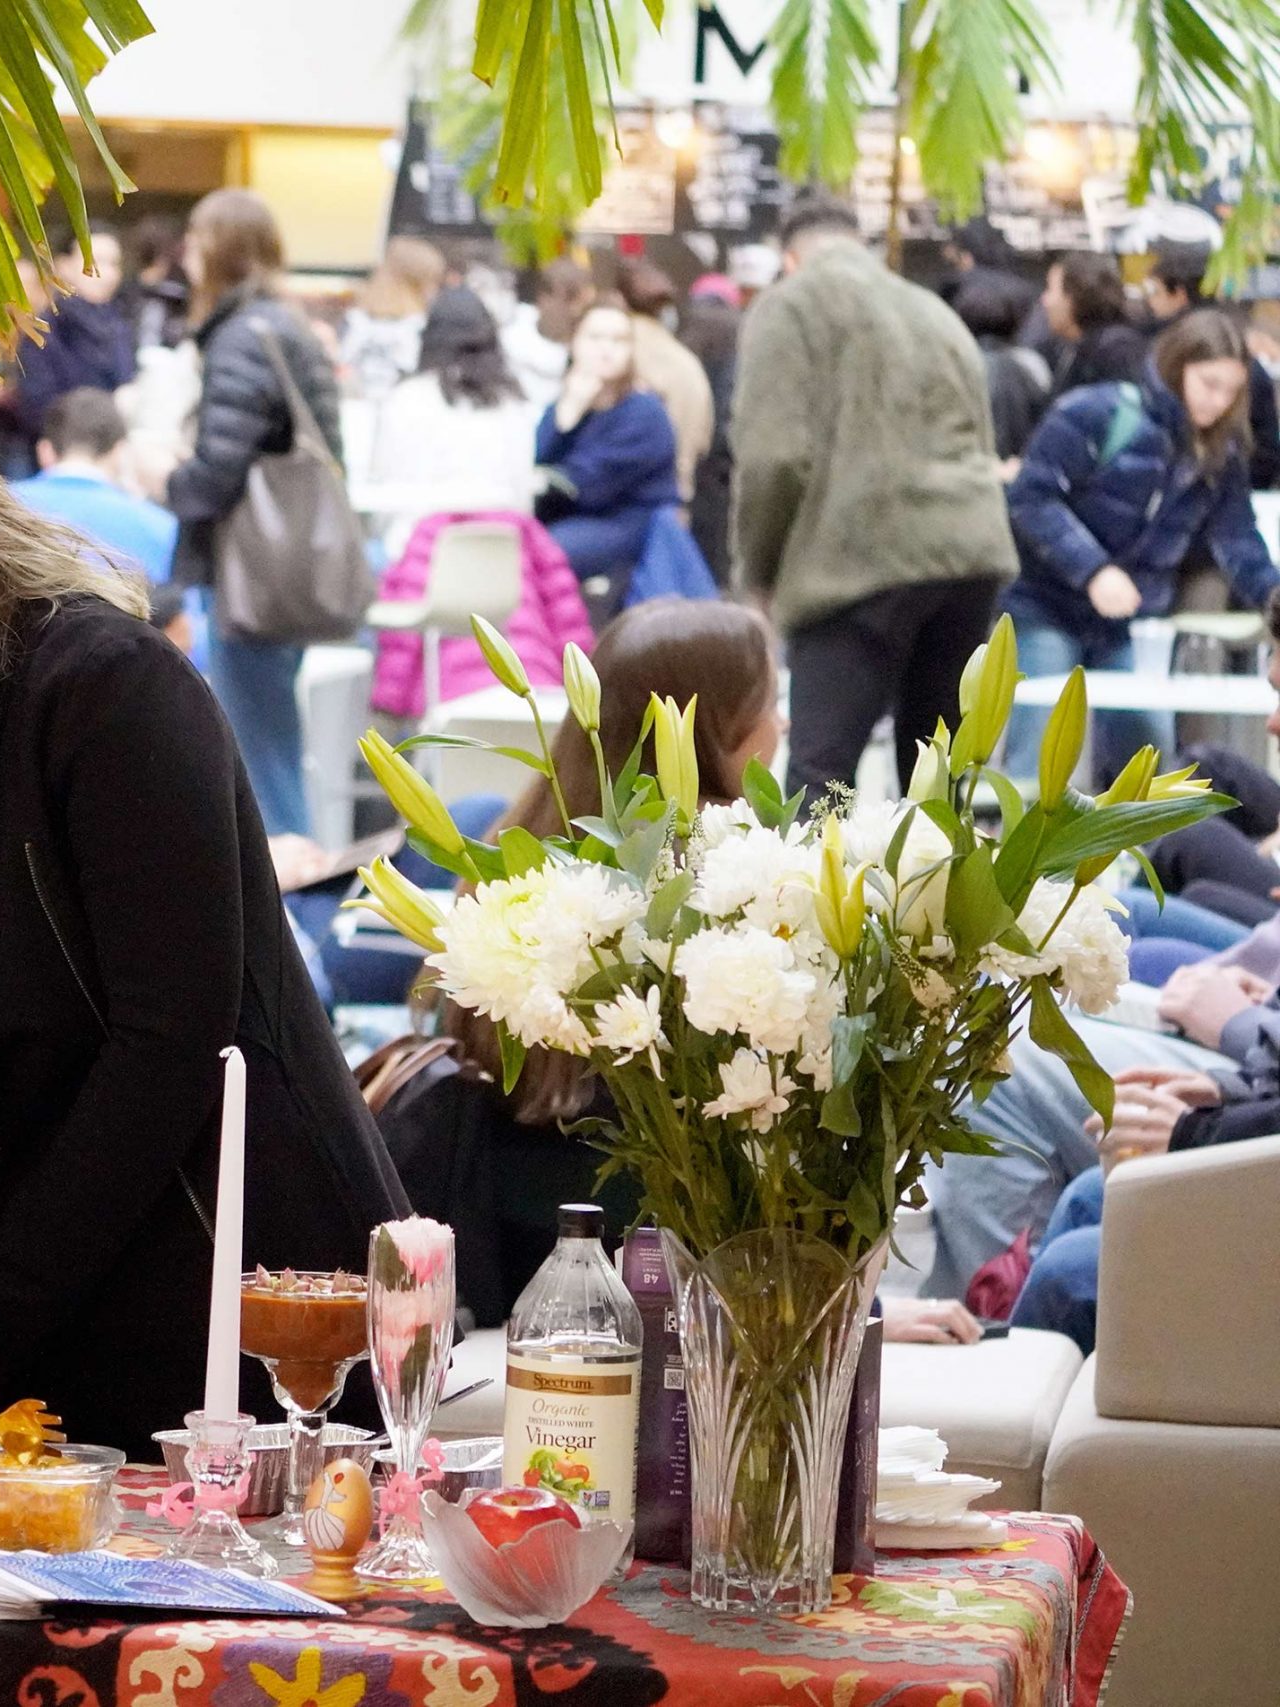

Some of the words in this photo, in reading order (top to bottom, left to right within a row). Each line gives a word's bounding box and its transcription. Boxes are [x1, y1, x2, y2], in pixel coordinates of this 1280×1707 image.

[643, 1273, 659, 1284] 48
[532, 1398, 590, 1417] Organic
[528, 1416, 565, 1427] DISTILLED
[566, 1420, 594, 1428] WHITE
[526, 1425, 596, 1454] Vinegar
